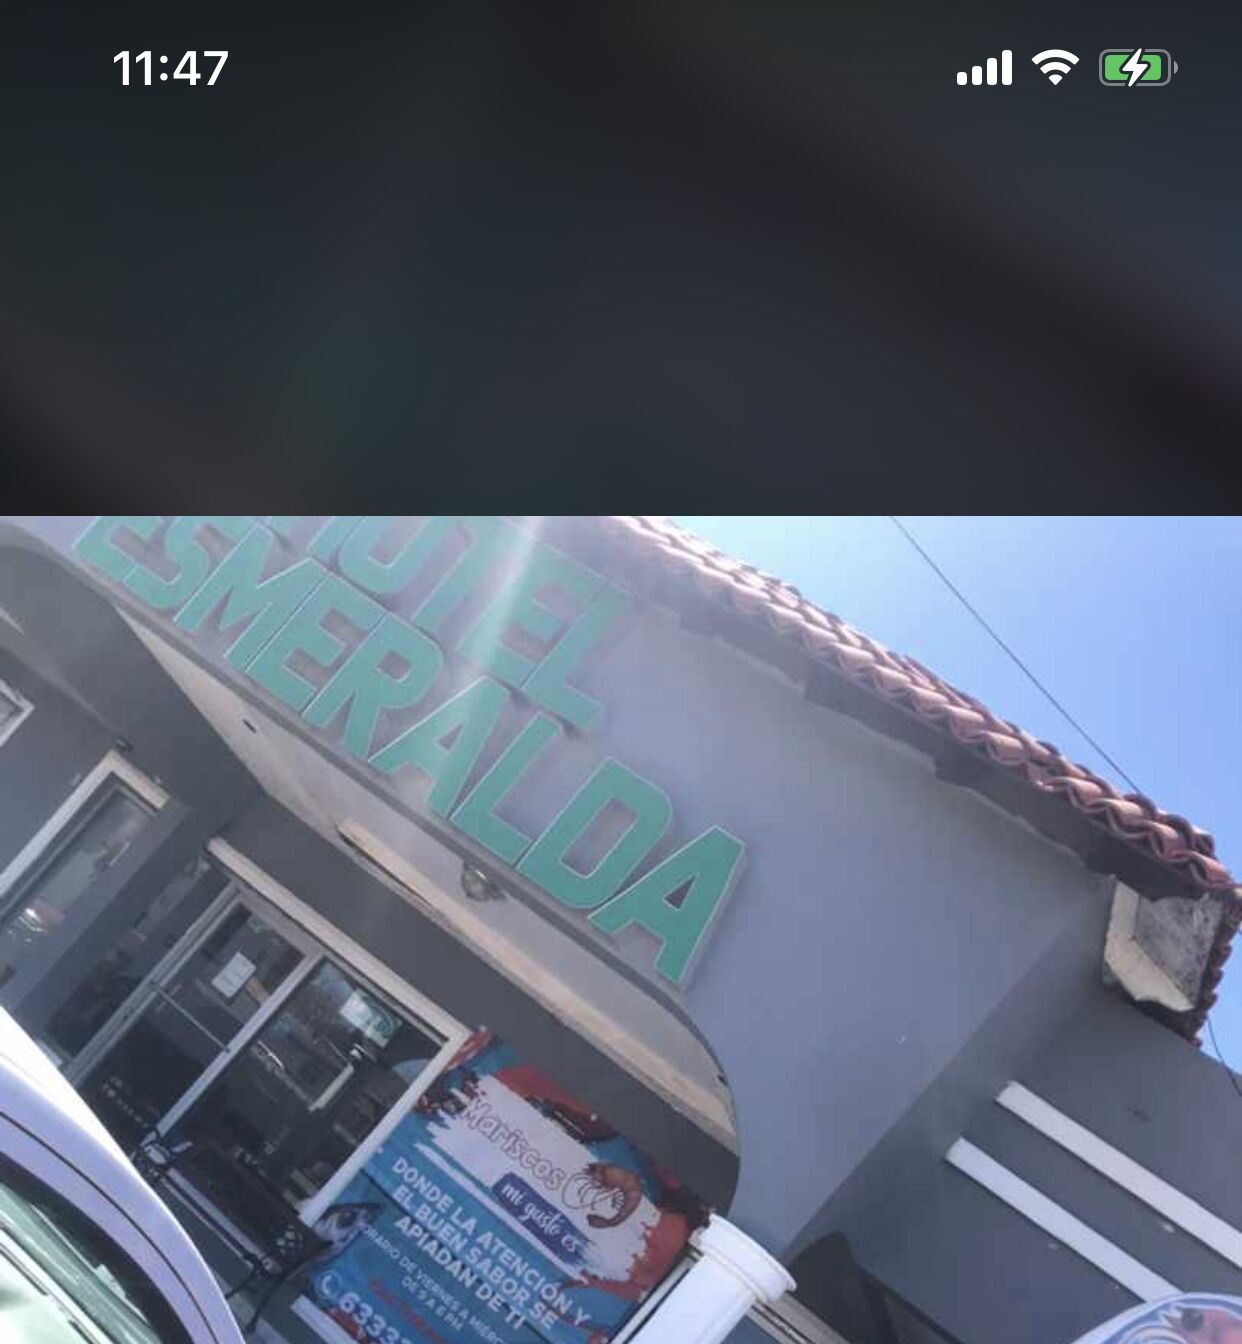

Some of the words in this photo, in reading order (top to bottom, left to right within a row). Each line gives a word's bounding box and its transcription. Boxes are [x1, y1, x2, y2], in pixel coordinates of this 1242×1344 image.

[262, 517, 629, 730] OTEL
[461, 1098, 566, 1190] Mariscos
[392, 1156, 454, 1213] DONDE
[451, 1206, 477, 1235] LA
[573, 1308, 592, 1326] Y
[393, 1184, 416, 1209] EL
[414, 1203, 468, 1251] BUEN
[465, 1246, 532, 1308] SABOR
[530, 1301, 559, 1329] SE
[395, 1216, 478, 1289] APIADAN
[475, 1283, 502, 1312] DE
[505, 1305, 527, 1330] TI
[399, 1257, 418, 1274] DE
[416, 1268, 461, 1312] VIERNES
[458, 1309, 470, 1320] A
[401, 1275, 417, 1293] DE
[443, 1312, 465, 1331] PM
